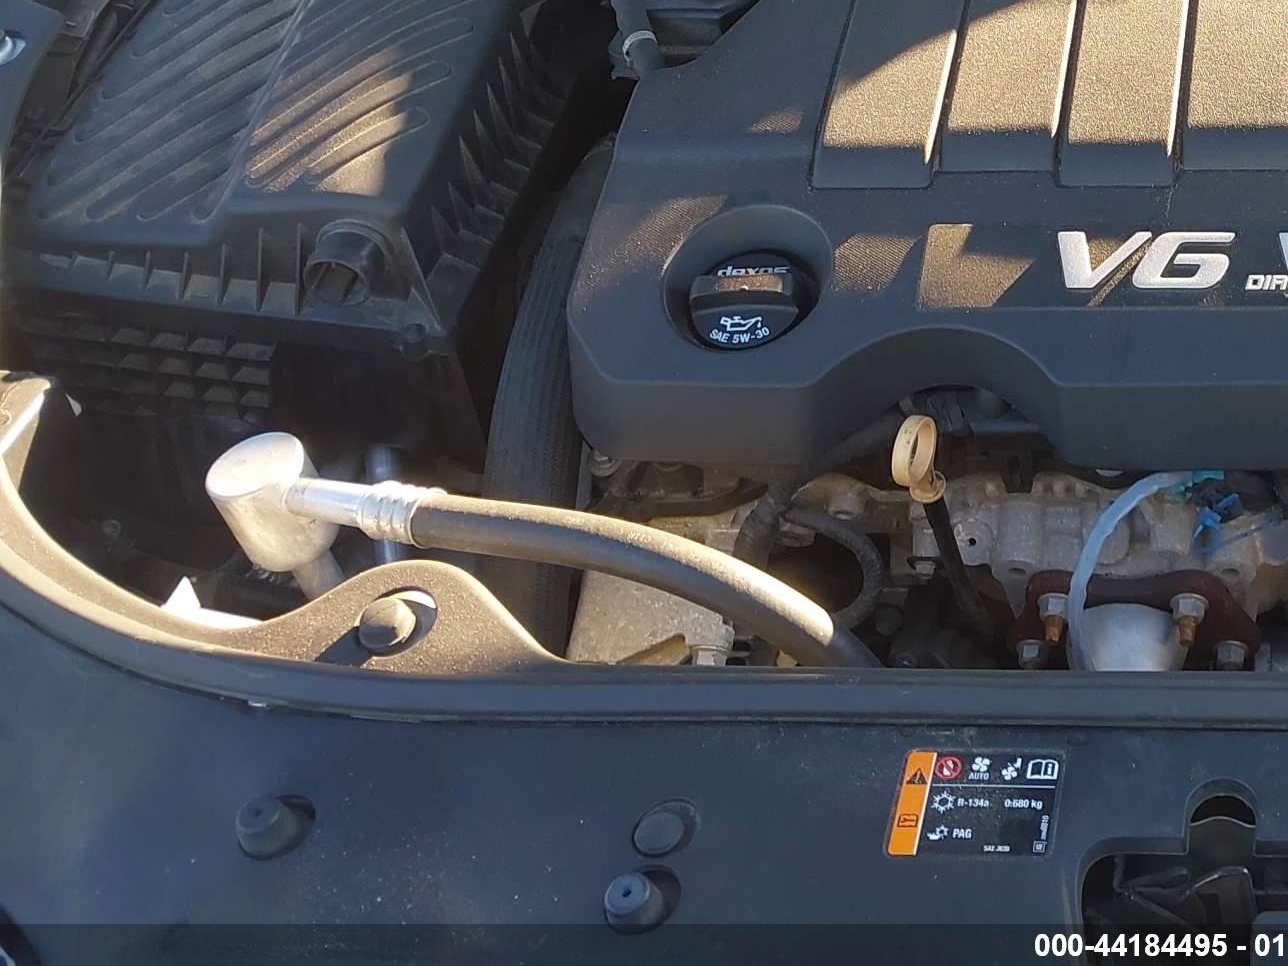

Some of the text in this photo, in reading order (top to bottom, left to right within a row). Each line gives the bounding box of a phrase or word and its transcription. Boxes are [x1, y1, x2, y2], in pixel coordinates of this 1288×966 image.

[1057, 230, 1236, 290] V6
[709, 327, 770, 344] SAE 5W-30
[968, 772, 990, 780] AUTO
[957, 797, 990, 808] R-134a
[1031, 799, 1043, 811] kg
[952, 828, 973, 839] PAG
